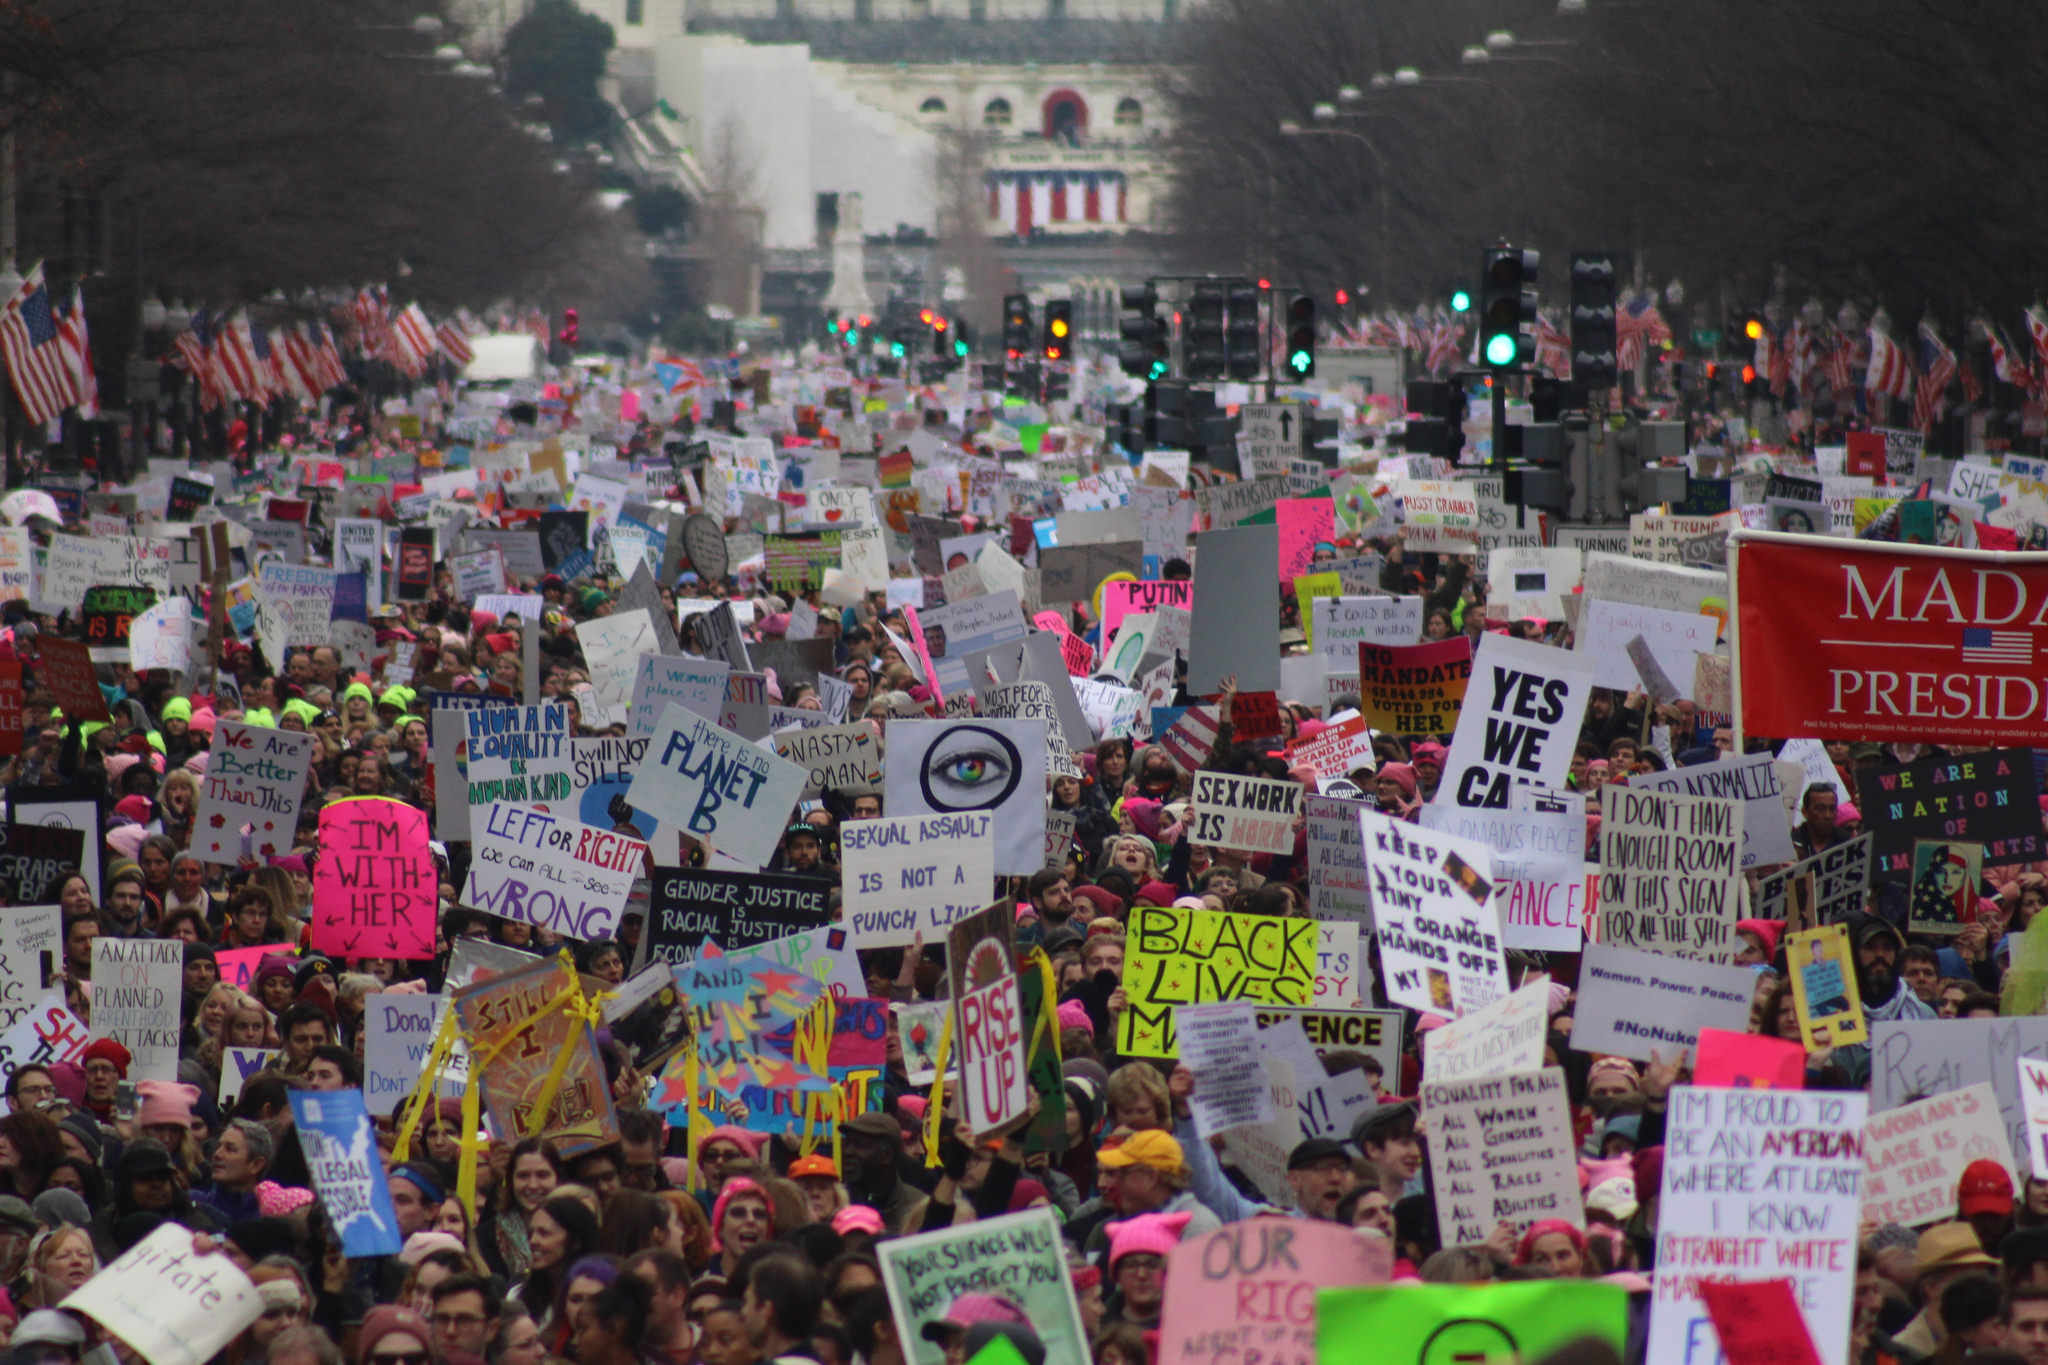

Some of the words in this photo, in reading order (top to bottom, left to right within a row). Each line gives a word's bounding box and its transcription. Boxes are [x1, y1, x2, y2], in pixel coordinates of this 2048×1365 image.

[820, 490, 856, 507] ONLY
[1403, 495, 1433, 511] PUSSY
[340, 526, 375, 537] UNITED
[1673, 519, 1721, 533] TRUMP
[1573, 537, 1628, 553] TURNING
[265, 567, 338, 582] FREEDOM
[292, 580, 335, 597] PRESS
[88, 617, 107, 638] IS
[1363, 646, 1393, 665] NO
[1363, 659, 1472, 685] MANDATE
[1373, 699, 1424, 713] VOTED
[1491, 665, 1569, 724] YES
[468, 704, 565, 737] HUMAN
[1396, 715, 1444, 732] HER
[222, 728, 255, 750] We
[264, 736, 299, 757] Are
[468, 733, 565, 762] EQUALITY
[791, 733, 856, 763] NASTY
[1324, 743, 1368, 765] SOCIAL
[1337, 738, 1354, 751] UP
[1483, 717, 1550, 772] WE
[211, 751, 299, 782] Better
[510, 759, 528, 776] BE
[661, 730, 768, 809] PLANET
[804, 760, 869, 789] OMAN
[1686, 760, 1780, 802] NORMALIZE
[1880, 772, 1913, 790] WE
[1933, 763, 1976, 784] ARE
[1996, 759, 2011, 776] A
[209, 777, 256, 808] Than
[257, 786, 294, 815] This
[468, 775, 528, 805] HUMAN
[531, 771, 572, 802] KIND
[1196, 776, 1241, 808] SEX
[1242, 781, 1299, 815] WORK
[688, 786, 723, 836] B
[1625, 793, 1687, 832] DON'T
[1690, 801, 1736, 838] HAVE
[1890, 789, 2009, 820] NATION
[350, 819, 401, 855] I'M
[486, 804, 556, 849] LEFT
[549, 828, 573, 854] OR
[843, 823, 911, 849] SEXUAL
[919, 815, 991, 842] ASSAULT
[1196, 813, 1226, 842] IS
[1230, 817, 1287, 851] WORK
[1530, 824, 1580, 854] PLACE
[1374, 831, 1438, 864] KEEP
[1607, 831, 1669, 872] ENOUGH
[1674, 835, 1736, 878] ROOM
[334, 855, 419, 889] WITH
[859, 873, 884, 893] IS
[901, 866, 938, 889] NOT
[953, 864, 966, 885] A
[1390, 863, 1453, 899] YOUR
[469, 869, 613, 942] WRONG
[664, 878, 739, 905] GENDER
[744, 885, 825, 912] JUSTICE
[1602, 872, 1627, 905] ON
[1634, 874, 1670, 915] THIS
[1675, 876, 1727, 917] SIGN
[350, 893, 413, 928] HER
[661, 908, 722, 935] RACIAL
[731, 906, 747, 920] IS
[852, 909, 918, 936] PUNCH
[727, 937, 740, 949] IS
[1139, 908, 1313, 981] BLACK
[1413, 915, 1498, 953] ORANGE
[1606, 911, 1639, 947] FOR
[1694, 917, 1733, 948] SHIT
[100, 941, 126, 963] AN
[129, 942, 180, 965] ATTACK
[1379, 926, 1450, 963] HANDS
[1457, 950, 1499, 977] OFF
[120, 963, 149, 987] ON
[692, 967, 745, 990] AND
[1144, 959, 1306, 1006] LIVES
[1589, 966, 1645, 987] Women.
[1650, 976, 1696, 996] Power.
[1700, 986, 1748, 1004] Peace.
[94, 986, 164, 1010] PLANNED
[92, 1010, 174, 1028] PARENTHOOD
[963, 978, 1019, 1064] RISE
[1613, 1018, 1697, 1047] #NoNuke
[109, 1028, 179, 1050] ATTACKS
[982, 1050, 1016, 1125] UP
[1423, 1079, 1502, 1110] EQUALITY
[1509, 1075, 1536, 1098] FOR
[1538, 1075, 1560, 1091] ALL
[1441, 1114, 1467, 1131] ALL
[1474, 1106, 1538, 1129] WOMEN
[1674, 1091, 1710, 1127] I'M
[1723, 1093, 1801, 1127] PROUD
[1817, 1098, 1847, 1126] TO
[1866, 1092, 1980, 1143] WOMAN'S
[1444, 1137, 1470, 1153] ALL
[1482, 1125, 1544, 1147] GENDERS
[1669, 1127, 1701, 1159] BE
[1708, 1128, 1753, 1159] AN
[1760, 1127, 1864, 1159] AMERICAN
[1446, 1159, 1472, 1175] ALL
[1481, 1148, 1555, 1169] SEXUALITIES
[1450, 1180, 1475, 1196] ALL
[1490, 1172, 1543, 1193] RACES
[1667, 1161, 1757, 1194] WHERE
[1802, 1166, 1864, 1197] LEAST
[1451, 1204, 1475, 1221] ALL
[1492, 1193, 1557, 1218] ABILITIES
[1746, 1203, 1832, 1234] KNOW
[899, 1249, 942, 1288] YOUR
[940, 1237, 1009, 1269] SILENCE
[1008, 1229, 1052, 1254] WILL
[1202, 1225, 1300, 1281] OUR
[1660, 1232, 1768, 1267] STRAIGHT
[1776, 1239, 1849, 1273] WHITE
[907, 1280, 942, 1319] NOT
[944, 1264, 1022, 1301] PROTECT
[1024, 1262, 1059, 1288] YOU
